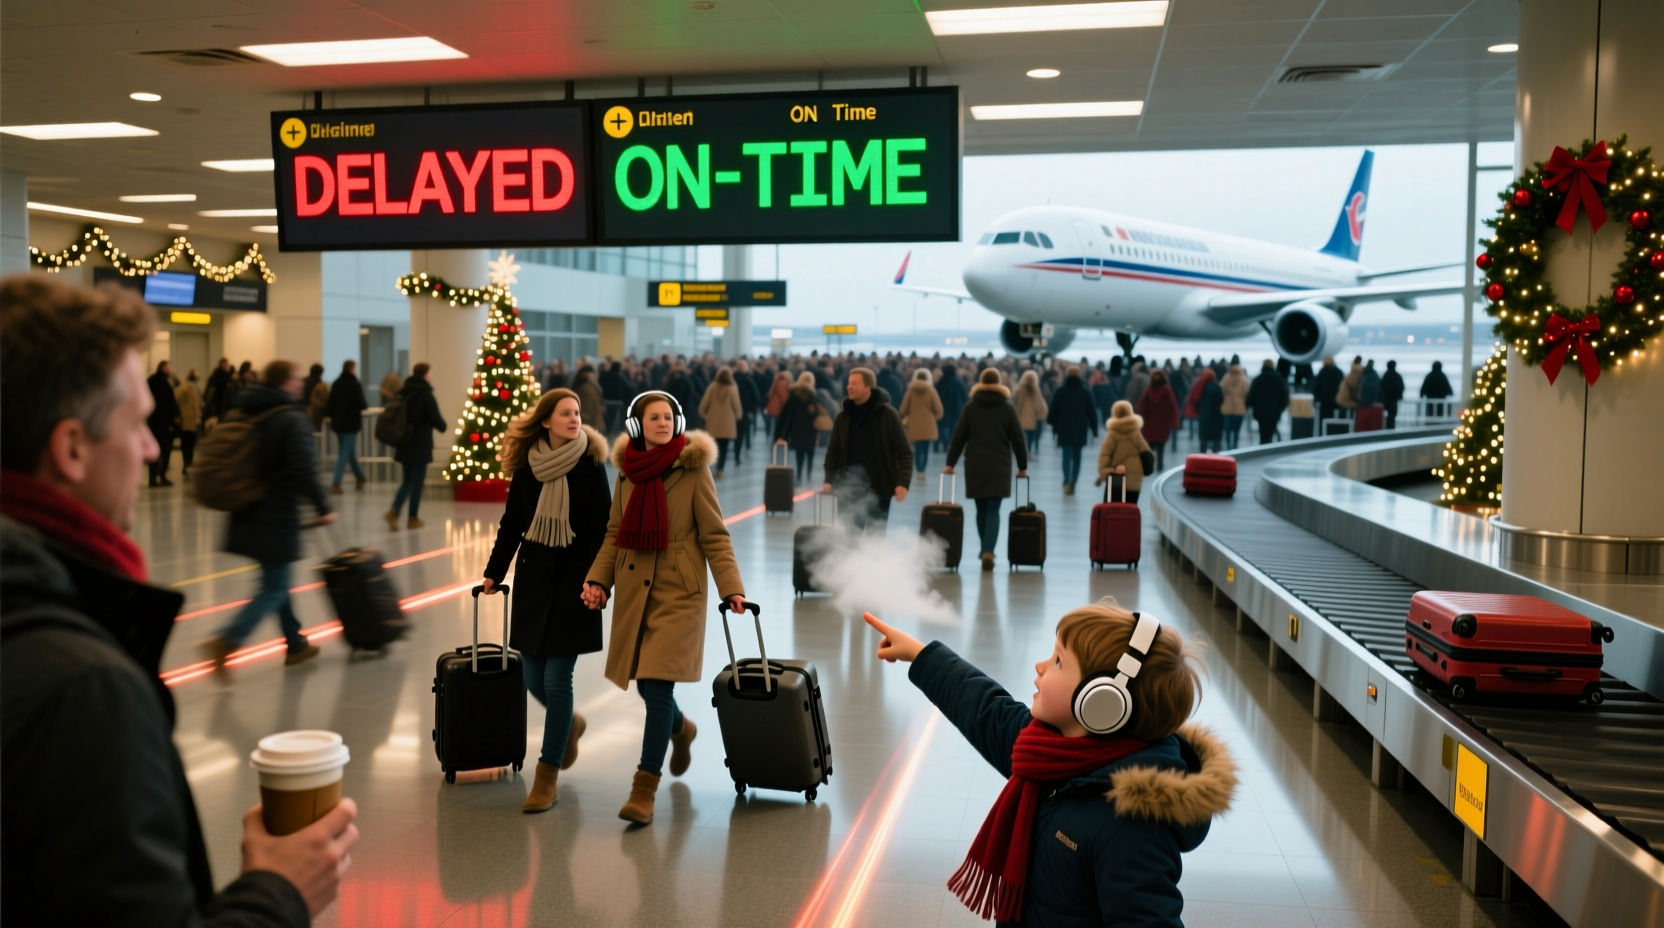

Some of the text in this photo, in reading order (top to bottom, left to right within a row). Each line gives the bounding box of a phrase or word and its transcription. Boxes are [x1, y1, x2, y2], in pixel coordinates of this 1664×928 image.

[790, 103, 877, 123] ON Time
[294, 148, 575, 217] DELAYED
[614, 138, 928, 211] ON-TIME
